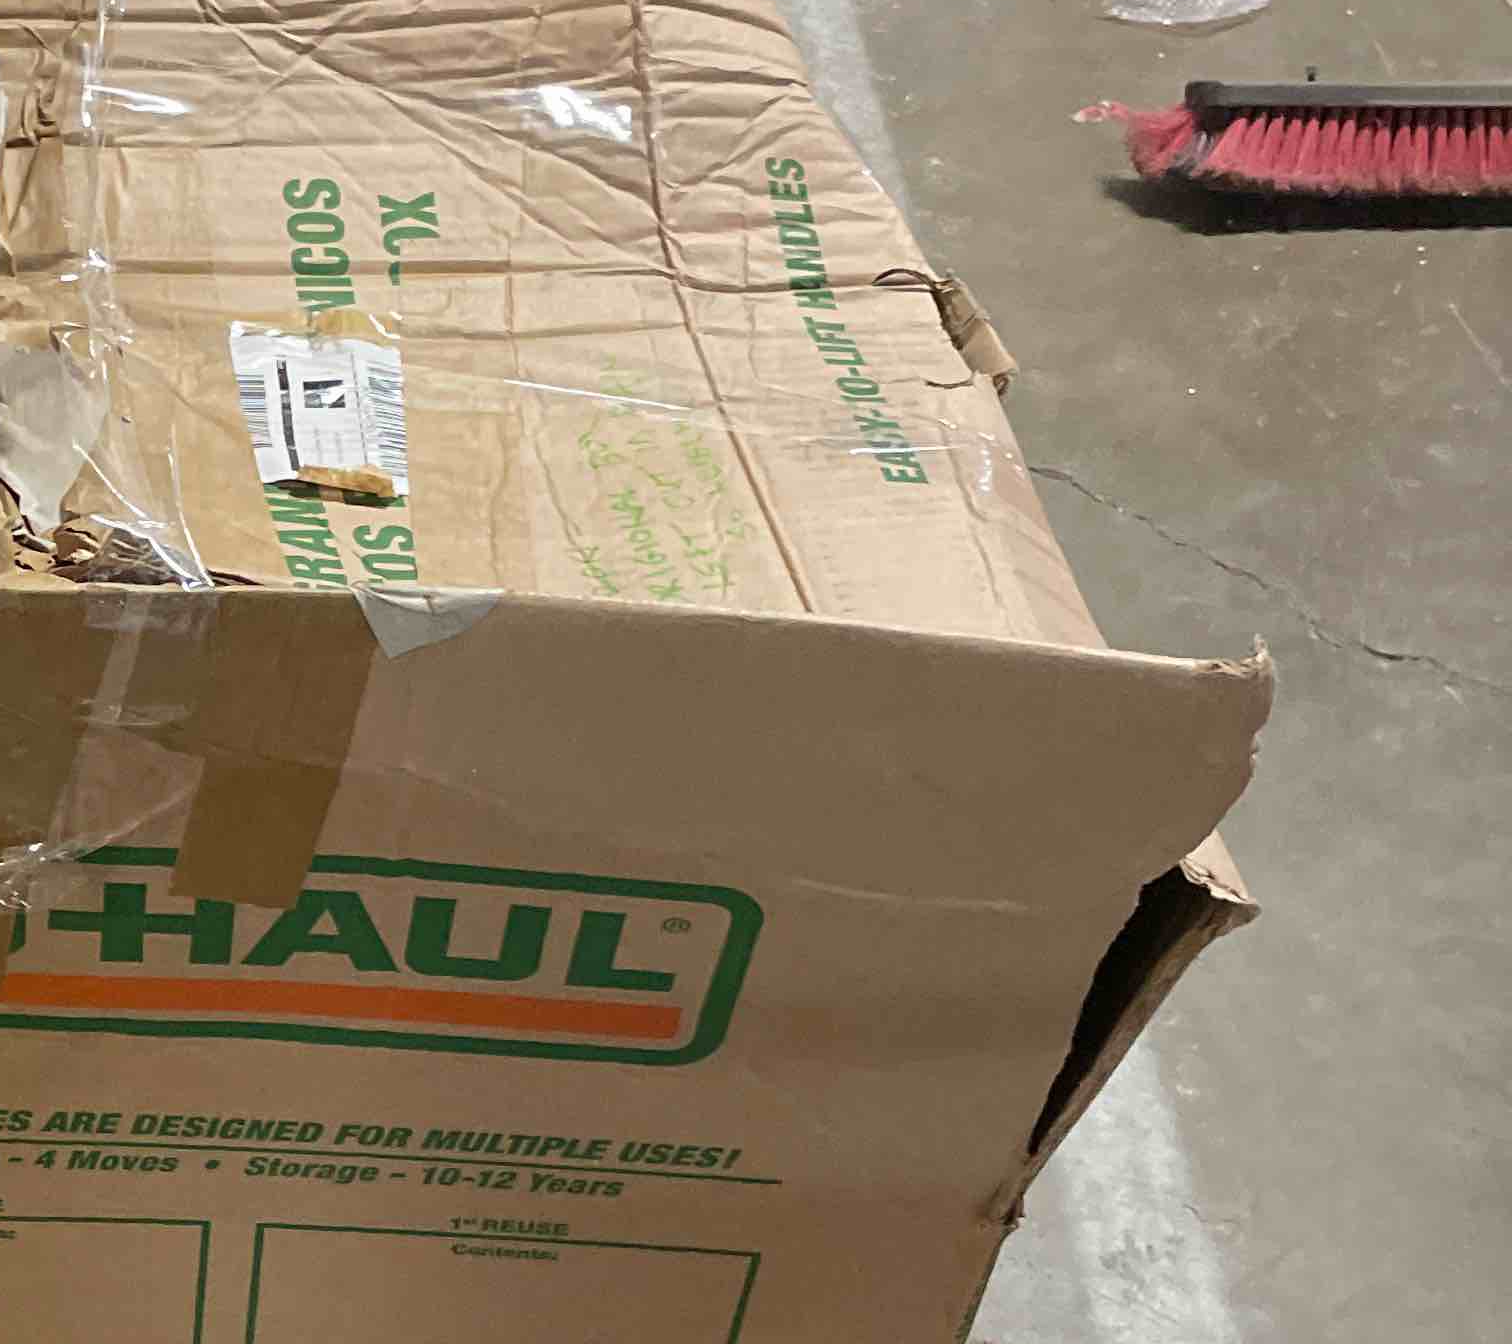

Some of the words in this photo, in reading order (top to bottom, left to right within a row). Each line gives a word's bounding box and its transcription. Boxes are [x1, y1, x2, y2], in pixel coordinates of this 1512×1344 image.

[764, 157, 838, 310] HANDLES
[40, 1110, 123, 1135] ARE
[129, 1113, 324, 1144] DESIGNED
[334, 1123, 413, 1148] FOR
[421, 1129, 614, 1162] MULTIPLE
[617, 1141, 742, 1170] USES!
[35, 1150, 56, 1170] 4
[66, 1150, 180, 1174] Moves
[244, 1156, 380, 1185] Storage
[421, 1165, 518, 1190] 10-12
[528, 1170, 625, 1198] Years
[481, 1217, 570, 1237] REUSE
